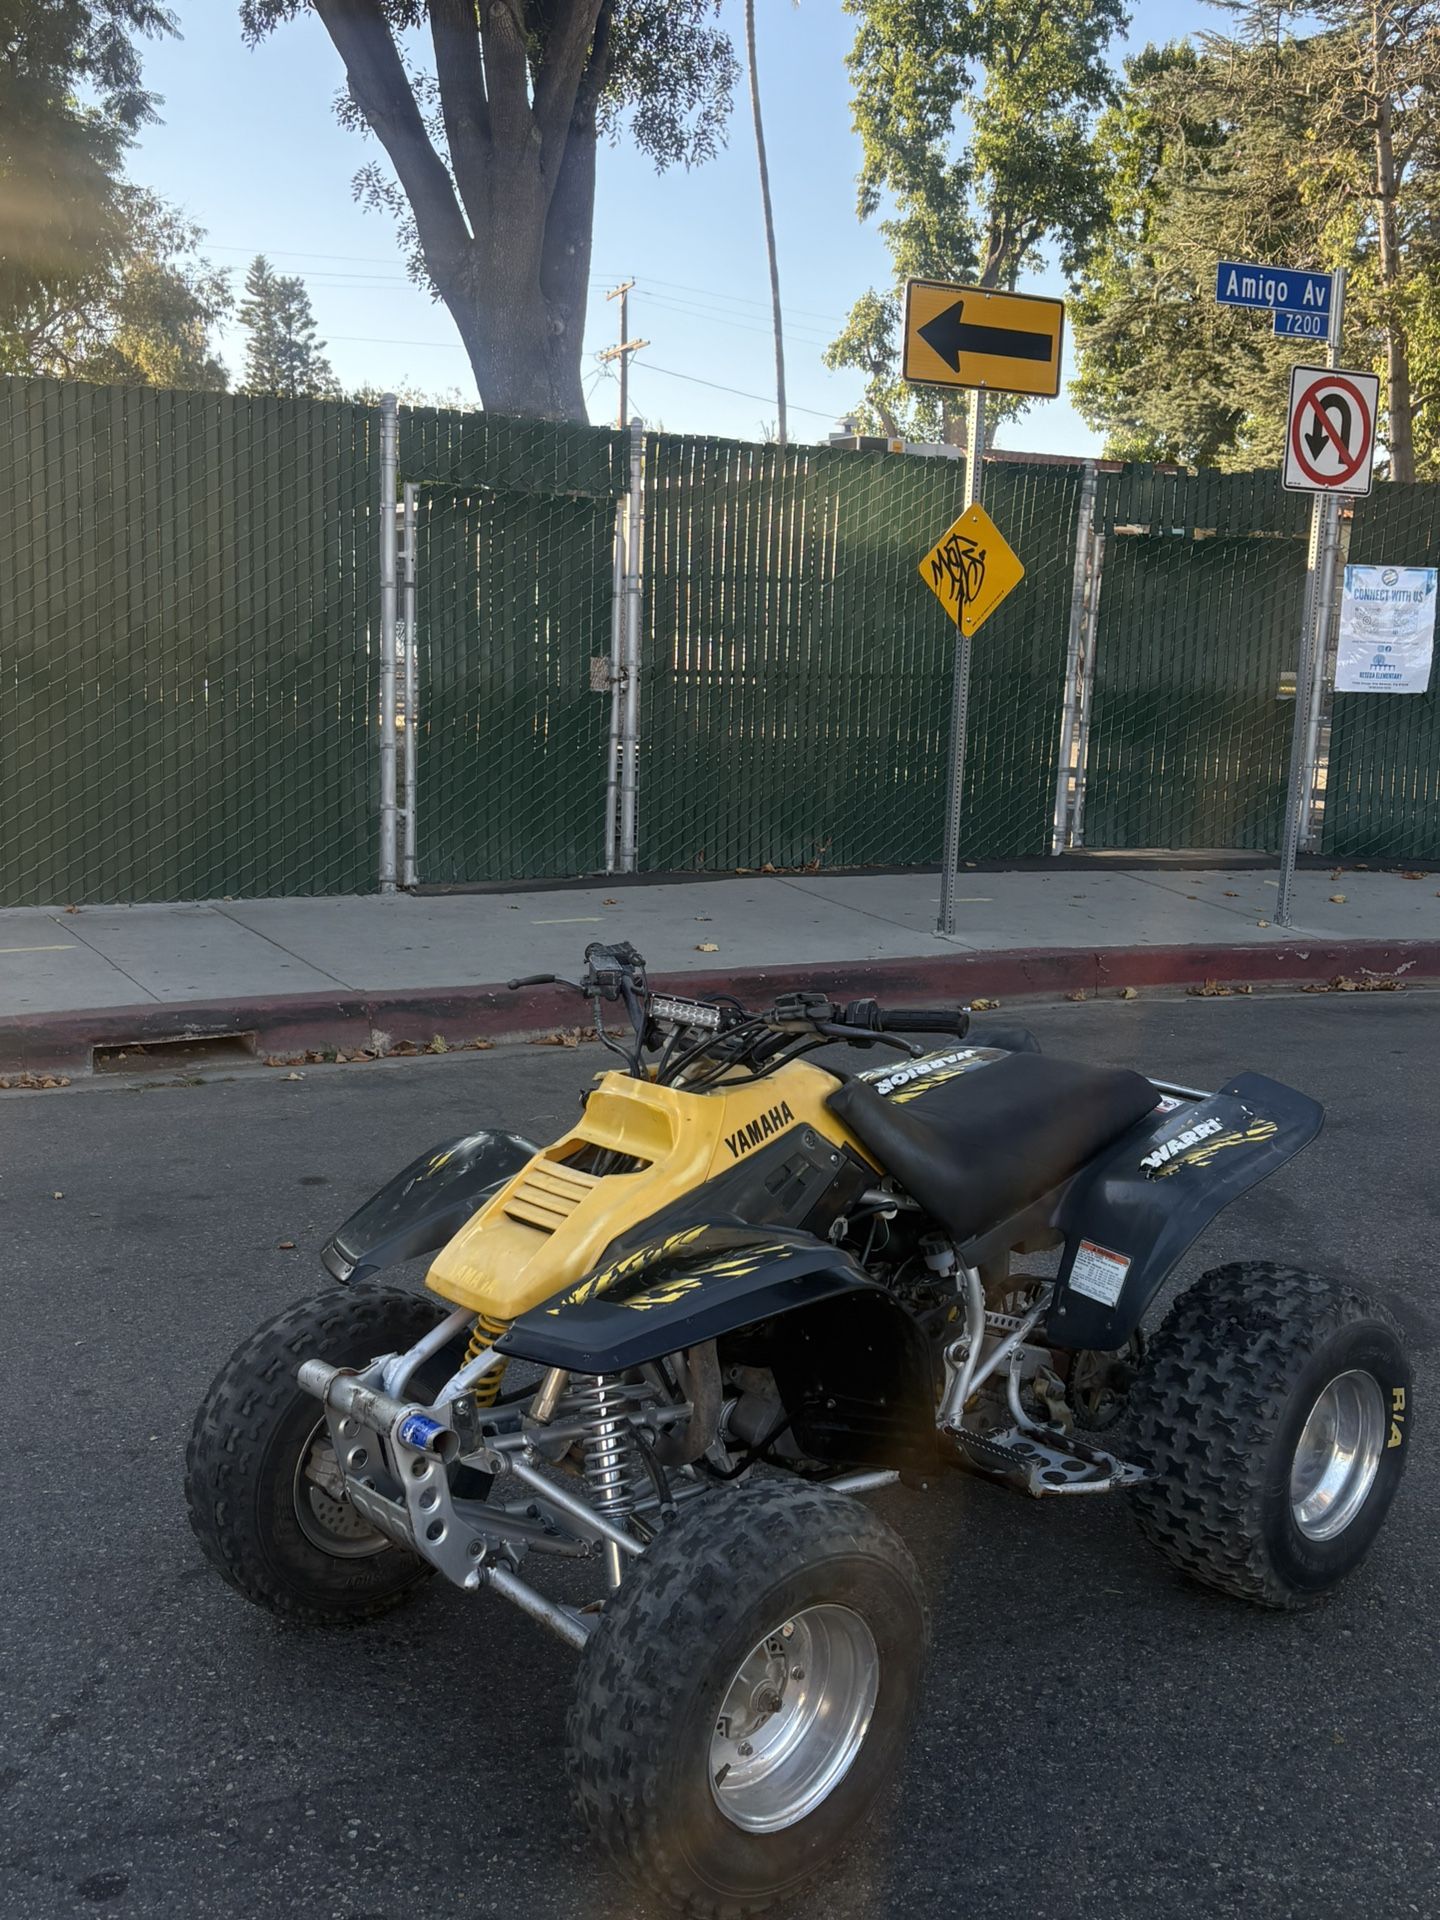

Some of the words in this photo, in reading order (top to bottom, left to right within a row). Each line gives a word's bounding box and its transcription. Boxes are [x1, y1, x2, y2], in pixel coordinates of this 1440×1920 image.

[1226, 269, 1288, 307] Amigo
[1303, 279, 1326, 307] Av
[1286, 313, 1321, 335] 7200
[1354, 588, 1389, 602] CONNECT
[1391, 589, 1412, 603] WITH
[1413, 590, 1424, 604] US
[874, 1049, 977, 1095] WARRIOR
[724, 1100, 795, 1158] YAMAHA
